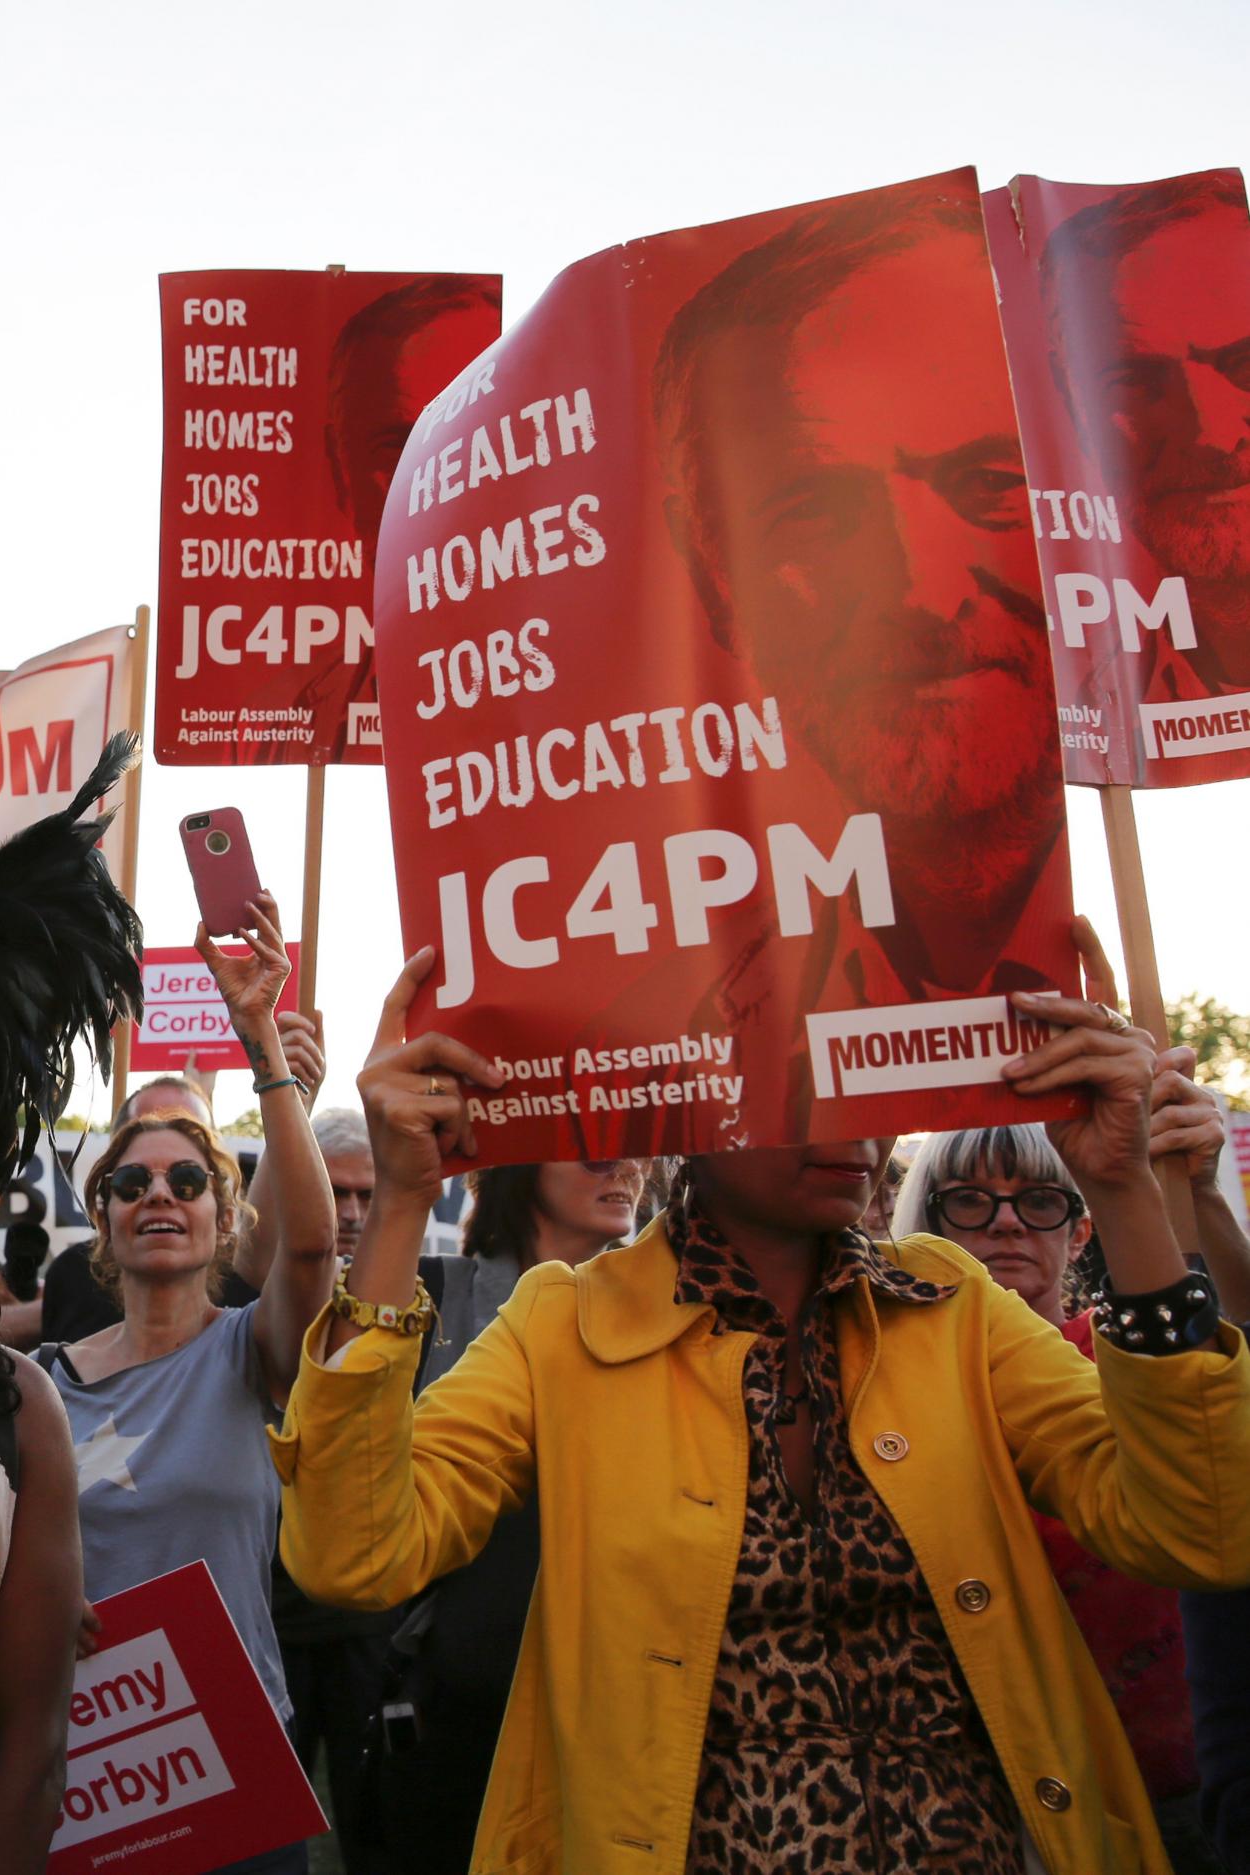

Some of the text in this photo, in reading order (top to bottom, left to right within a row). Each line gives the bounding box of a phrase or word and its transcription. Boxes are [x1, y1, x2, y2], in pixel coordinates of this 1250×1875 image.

[183, 298, 248, 327] FOR
[184, 345, 298, 387] HEALTH
[422, 361, 496, 444] FOR
[184, 409, 294, 453] HOMES
[408, 387, 598, 517] HEALTH
[181, 473, 259, 517] JOBS
[181, 538, 363, 580] EDUCATION
[406, 494, 607, 613] HOMES
[415, 618, 556, 720] JOBS
[177, 727, 315, 746] Against Austerity
[181, 707, 314, 724] Labour Assembly
[421, 696, 787, 829] EDUCATION
[436, 812, 897, 1009] JC4PM
[148, 1010, 231, 1036] Corby
[827, 1003, 1051, 1092] MOMENTUM
[495, 1032, 734, 1082] bour Assembly
[467, 1075, 744, 1126] Against Austerity
[42, 1746, 207, 1831] orbyn
